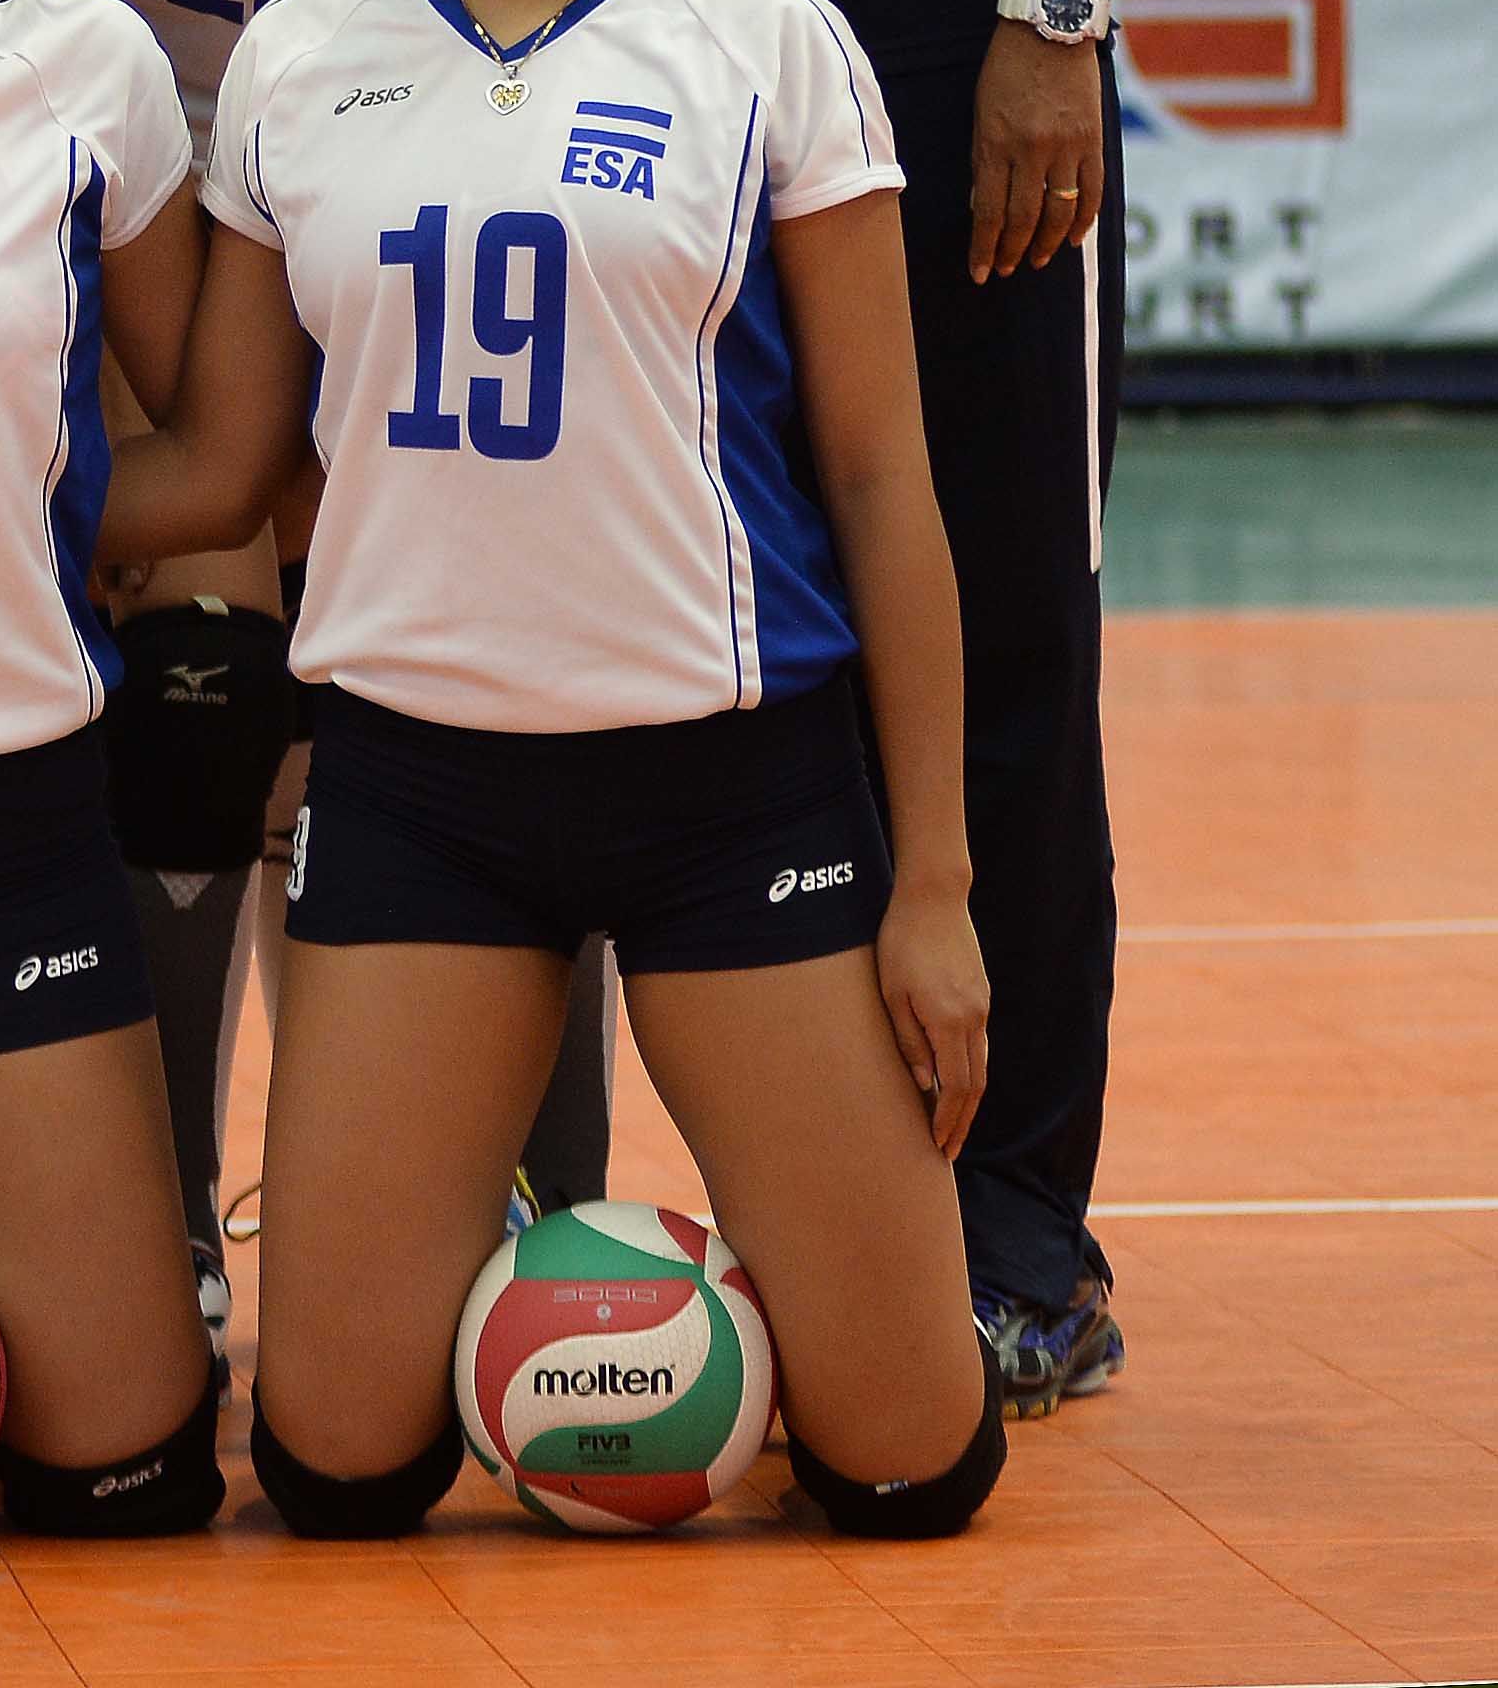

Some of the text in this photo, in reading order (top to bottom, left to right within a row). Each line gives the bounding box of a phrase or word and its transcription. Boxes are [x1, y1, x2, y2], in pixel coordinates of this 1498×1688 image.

[359, 82, 413, 107] asics
[560, 147, 657, 202] ESA
[378, 204, 568, 462] 19
[800, 861, 854, 893] asics
[45, 944, 100, 981] asics
[532, 1363, 674, 1396] molten
